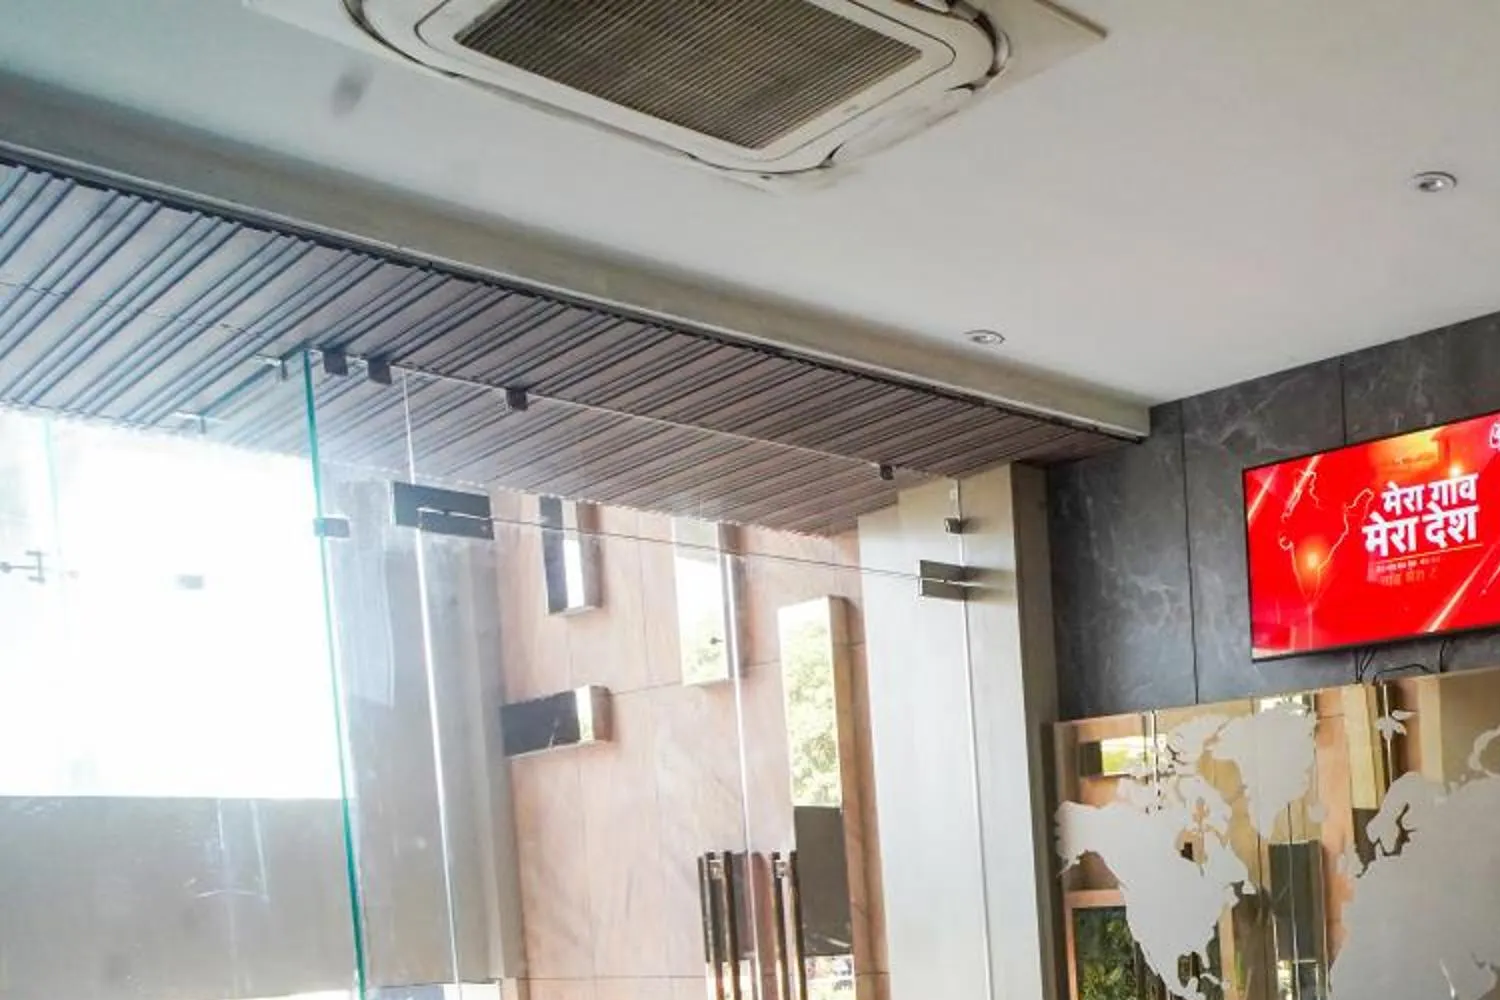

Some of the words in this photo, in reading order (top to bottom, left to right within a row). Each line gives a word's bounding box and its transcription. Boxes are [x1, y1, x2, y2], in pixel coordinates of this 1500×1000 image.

[1381, 481, 1425, 515] मेरा
[1361, 511, 1419, 556] मेरा
[1422, 501, 1480, 549] देश
